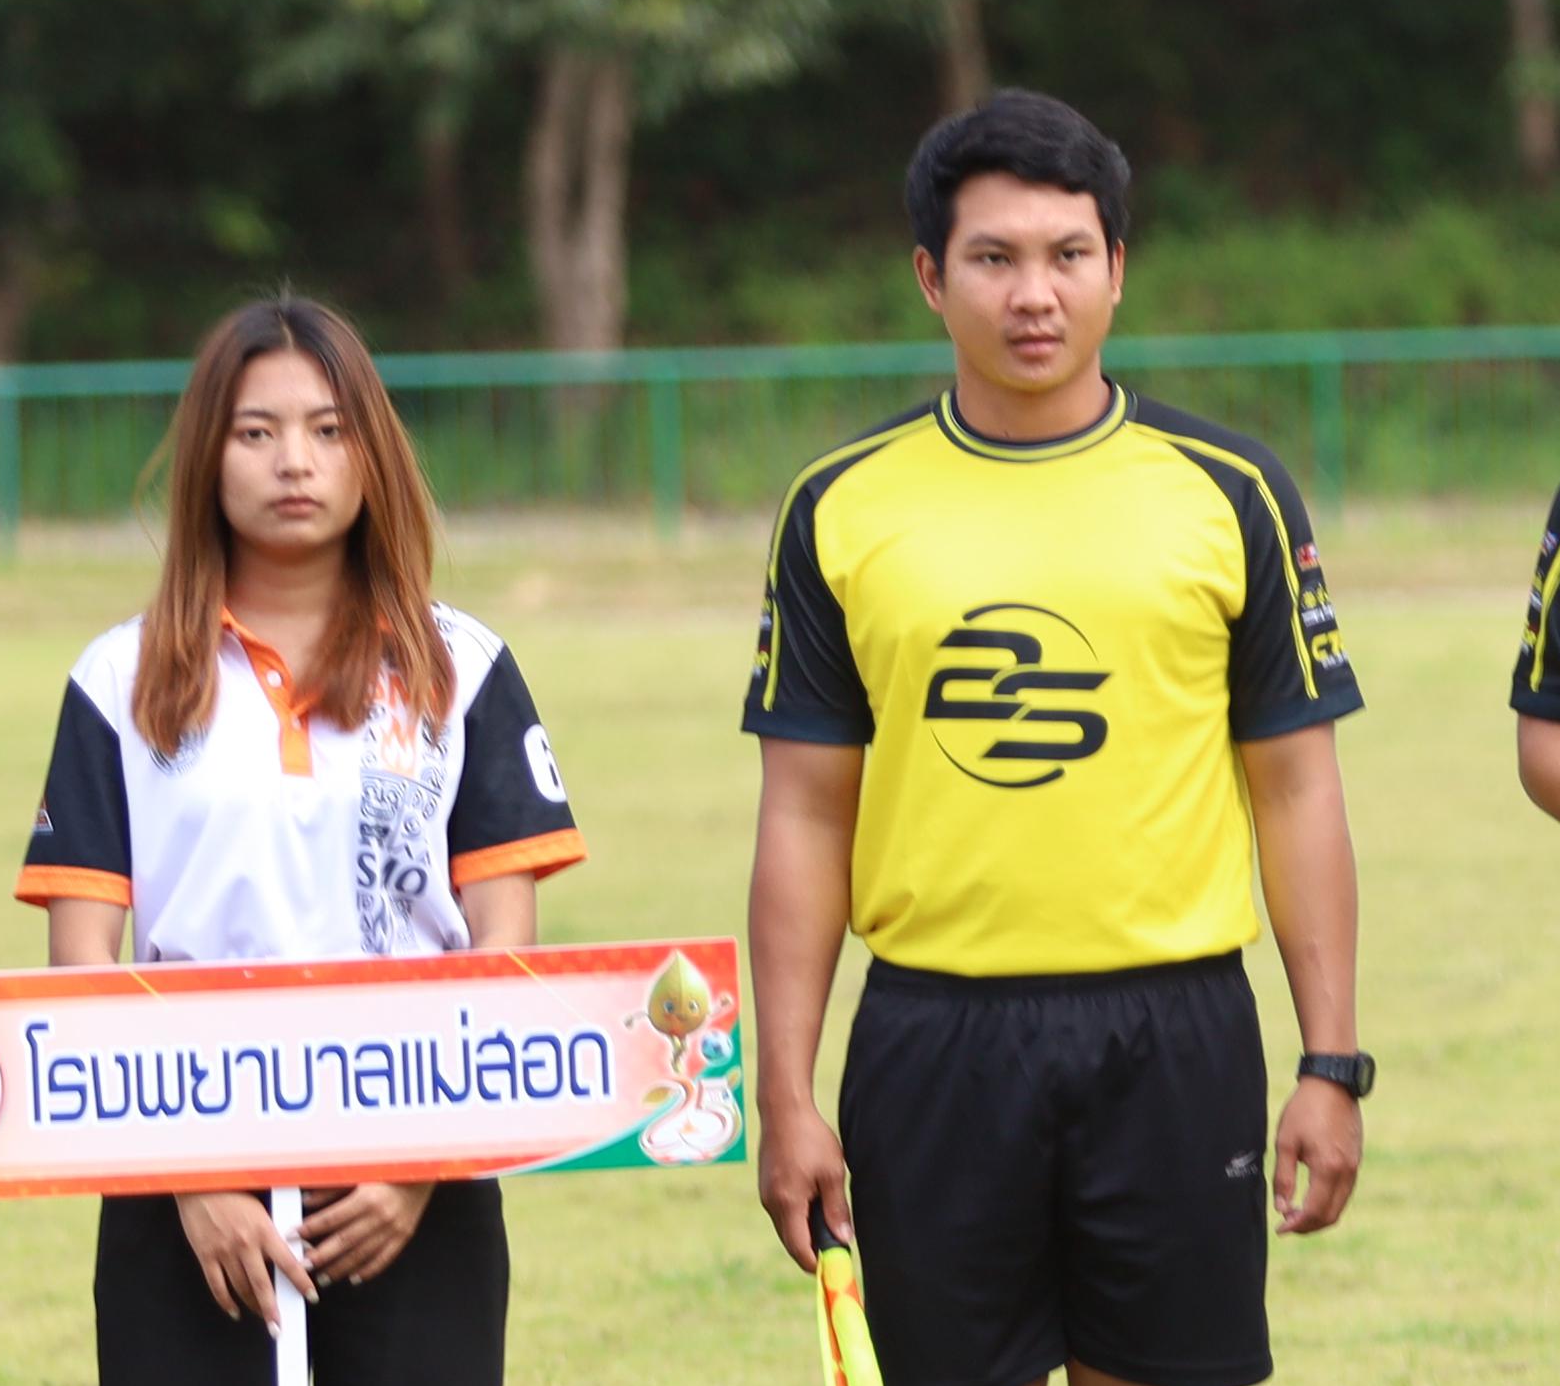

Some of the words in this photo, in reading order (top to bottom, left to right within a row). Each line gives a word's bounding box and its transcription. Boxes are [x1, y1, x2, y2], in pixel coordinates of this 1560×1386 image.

[25, 1009, 611, 1123] โรงพยาบาลแม่สอด
